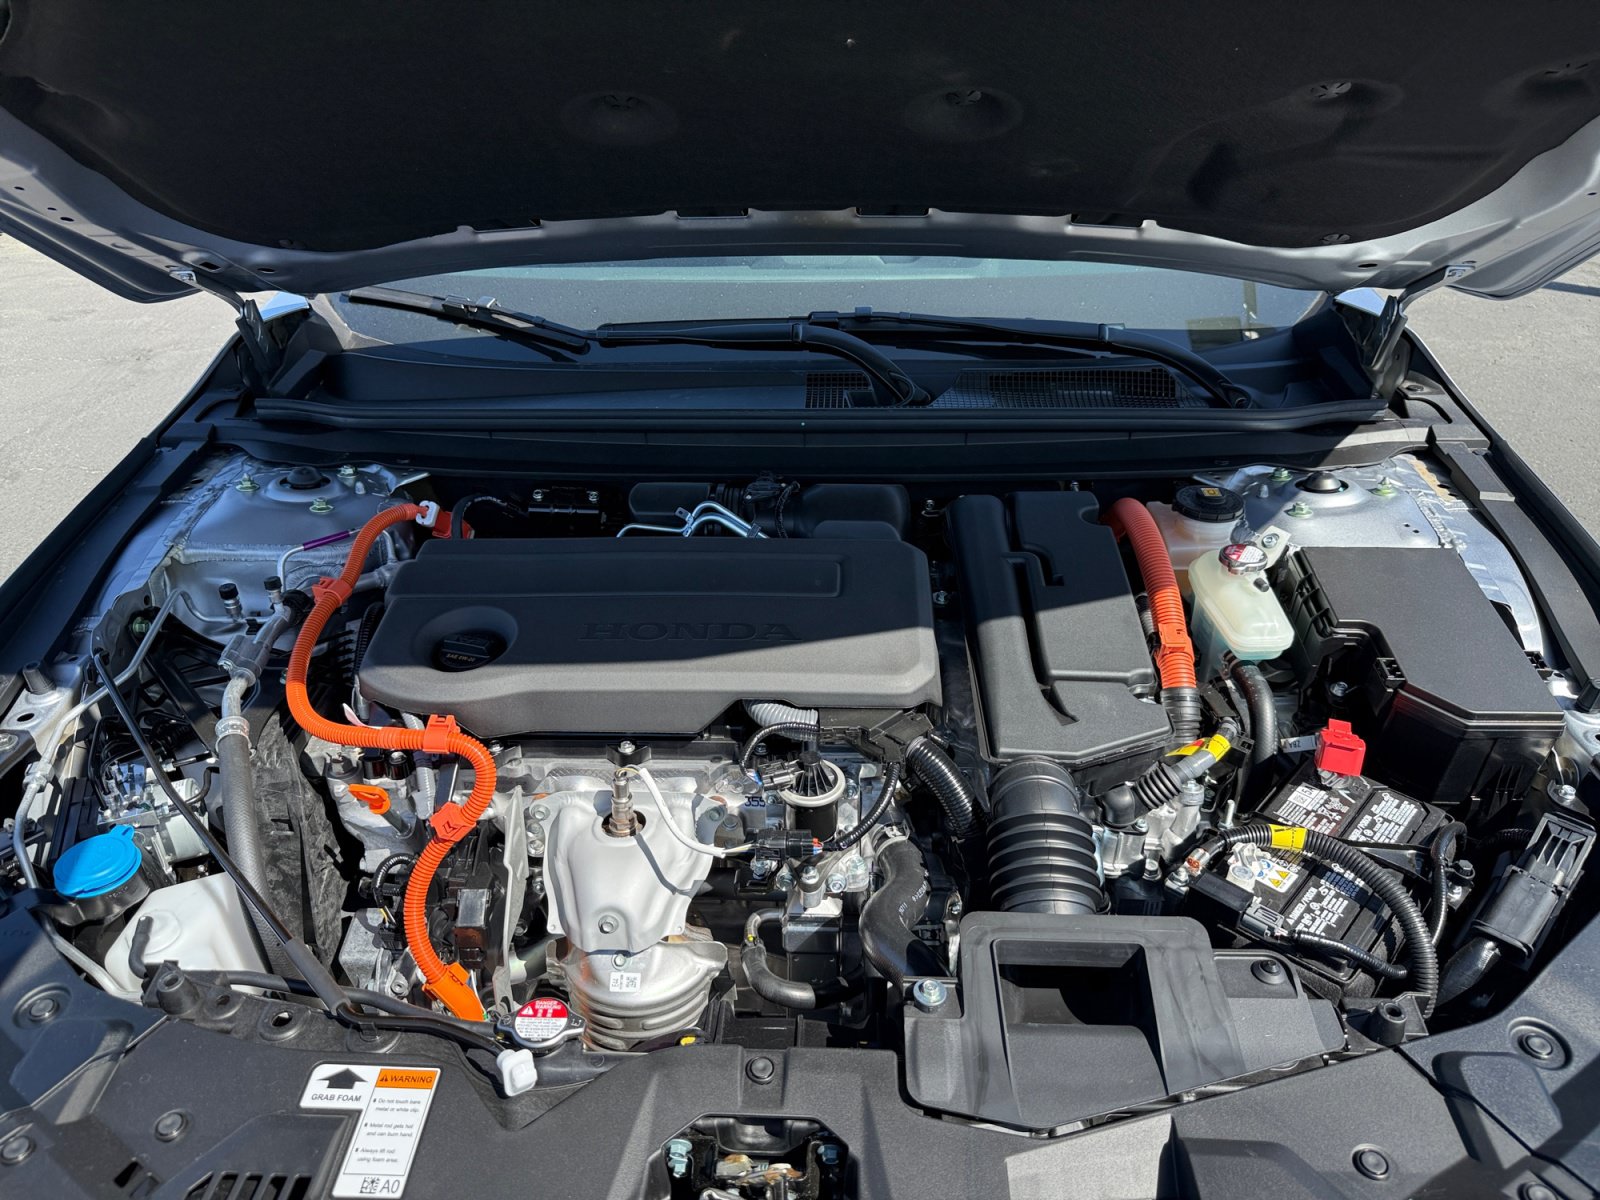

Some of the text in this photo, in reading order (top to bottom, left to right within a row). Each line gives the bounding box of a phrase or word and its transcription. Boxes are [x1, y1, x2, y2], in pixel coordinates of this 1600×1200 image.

[576, 622, 803, 642] HONDA
[744, 795, 766, 807] 355
[390, 1075, 433, 1084] WARNING
[311, 1093, 361, 1102] GRAB FOAM
[379, 1179, 401, 1194] A0
